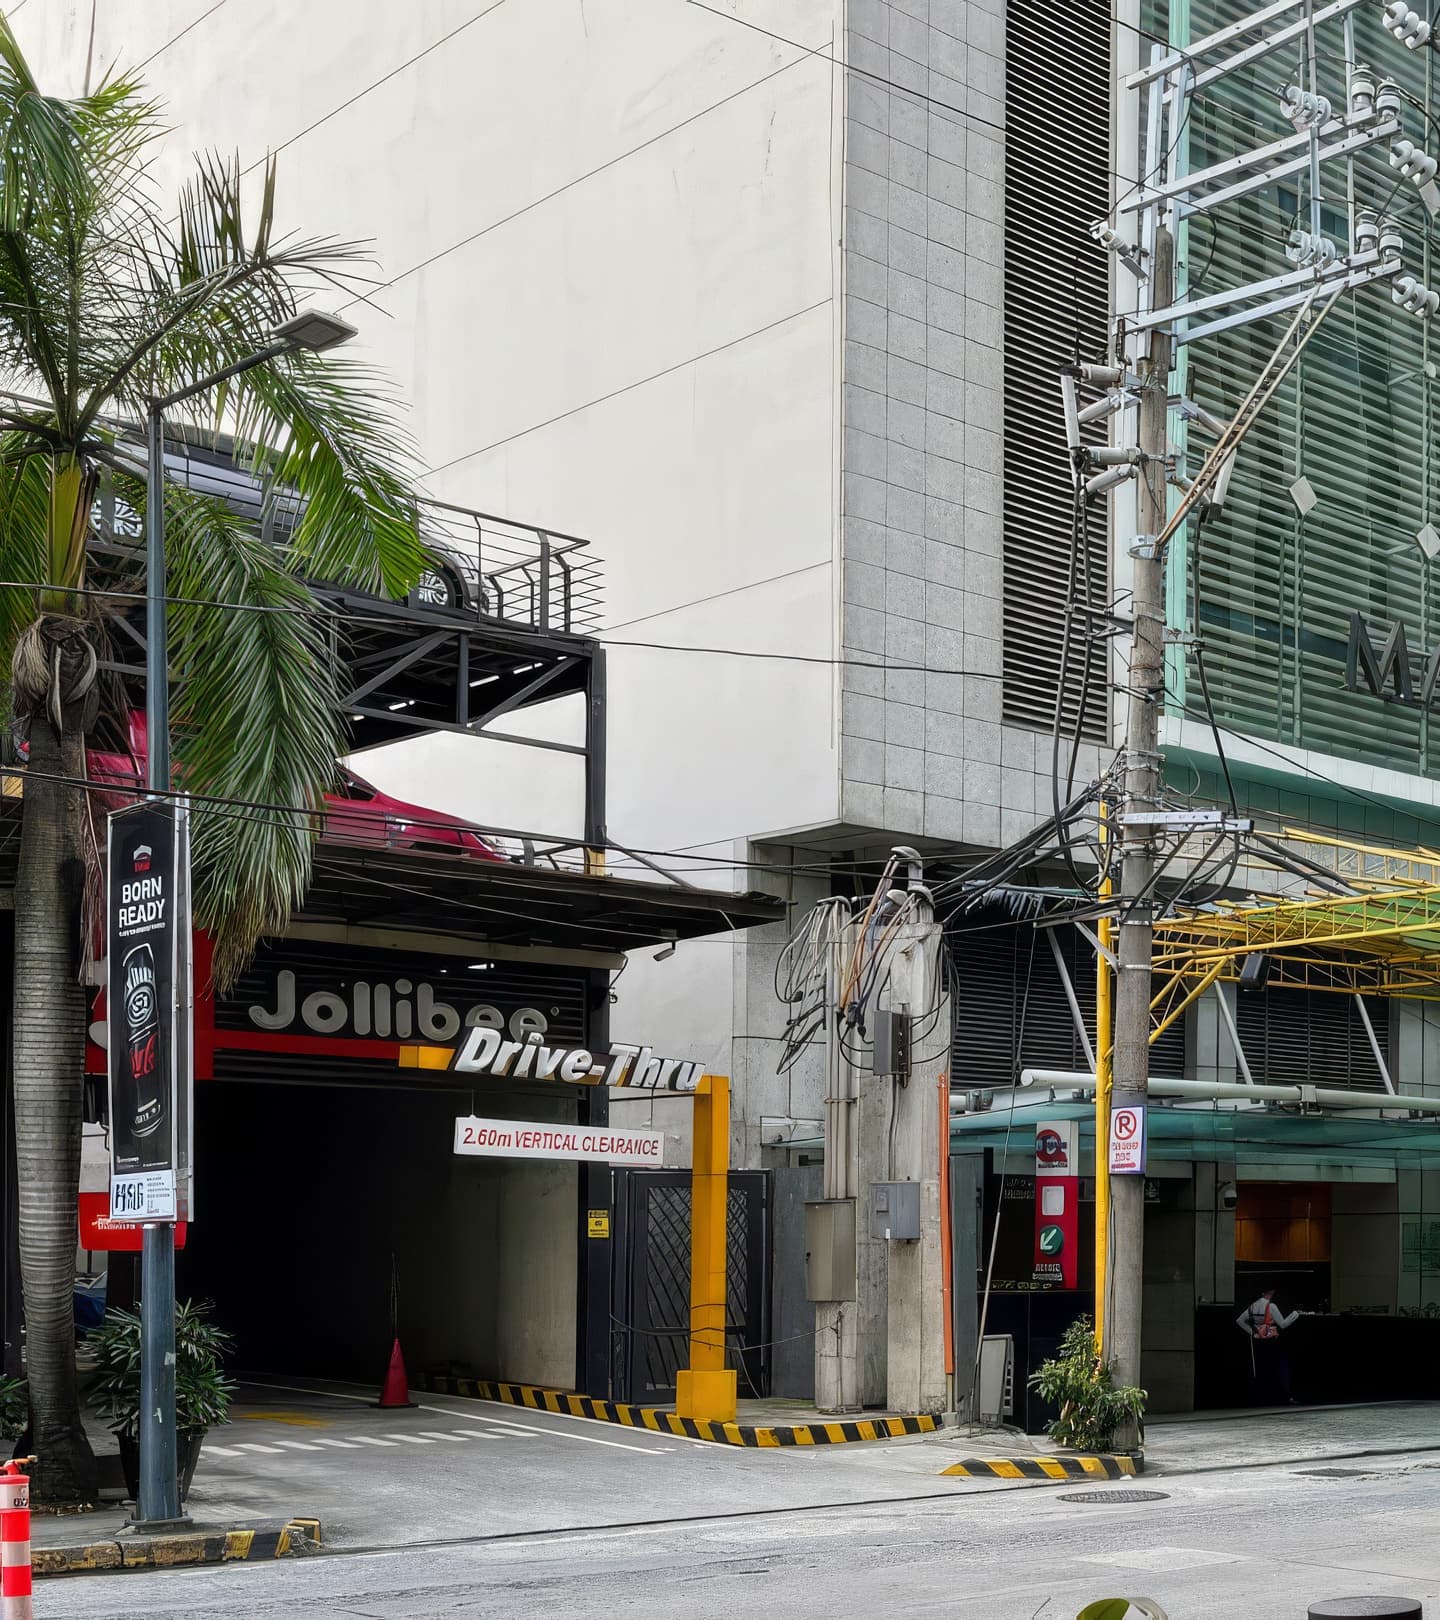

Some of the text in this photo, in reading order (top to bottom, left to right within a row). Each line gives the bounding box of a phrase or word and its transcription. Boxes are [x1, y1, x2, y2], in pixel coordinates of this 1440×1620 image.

[122, 875, 162, 904] BORN
[119, 898, 166, 929] READY
[248, 969, 548, 1045] Jollibee
[454, 1026, 707, 1092] Drive-Thru
[463, 1127, 659, 1156] 2.60m VERTICAL CLEARANCE
